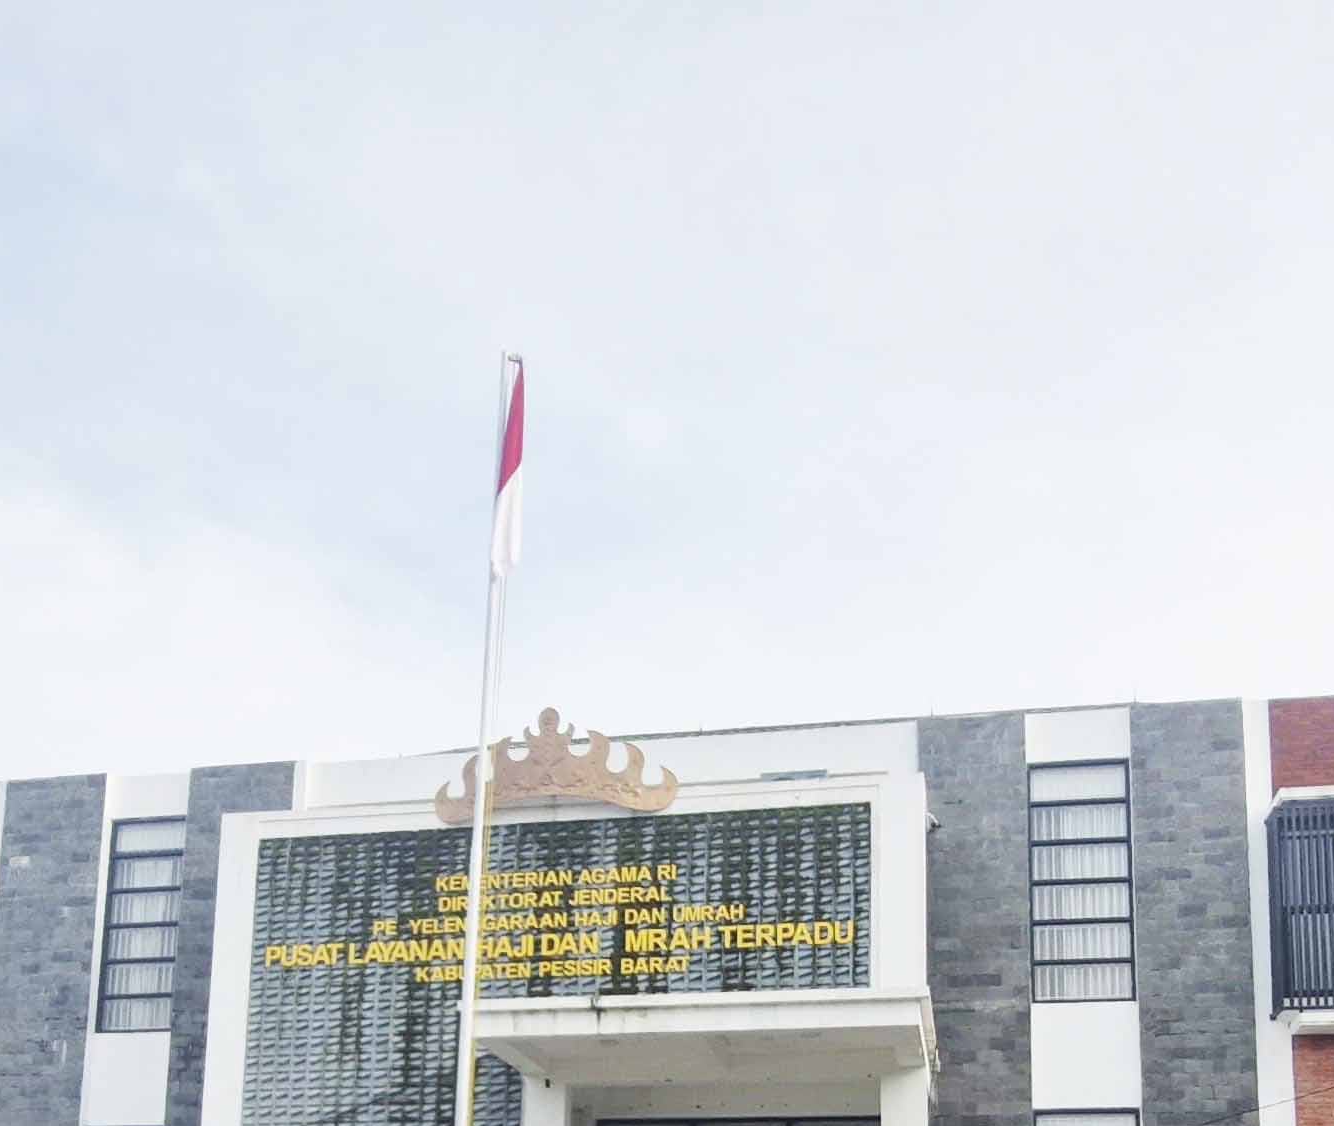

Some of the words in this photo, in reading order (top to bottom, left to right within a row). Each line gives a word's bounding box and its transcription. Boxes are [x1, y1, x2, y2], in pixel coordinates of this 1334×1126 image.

[578, 867, 652, 885] AGAMA
[657, 864, 677, 881] RI
[438, 890, 563, 912] DIRKTORAT
[569, 886, 672, 906] JENDERAL
[574, 909, 617, 927] HAJI
[624, 908, 666, 925] DAN
[673, 904, 745, 923] UMRAH
[265, 943, 345, 967] PUSAT
[348, 938, 464, 965] LAYANAN
[478, 934, 534, 959] HAJI
[541, 932, 598, 955] DAN
[719, 920, 854, 949] TERPADU
[539, 959, 611, 977] PESISIR
[621, 956, 690, 975] BARAT
